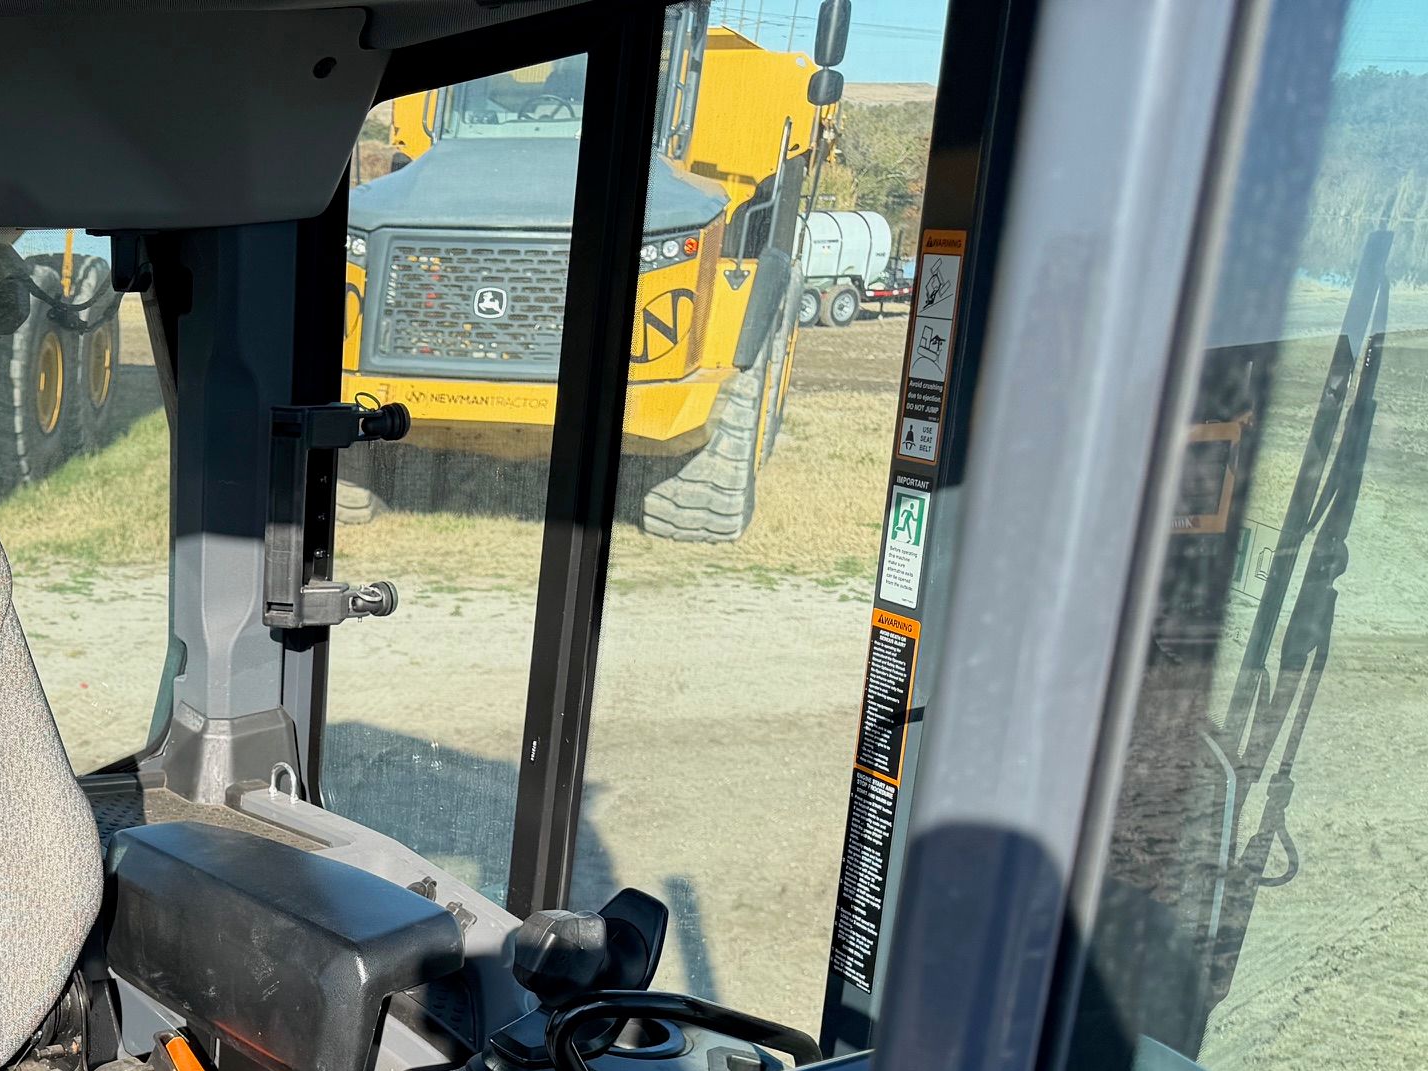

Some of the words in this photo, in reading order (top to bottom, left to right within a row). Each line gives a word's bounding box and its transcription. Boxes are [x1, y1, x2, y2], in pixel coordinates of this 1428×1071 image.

[931, 236, 962, 250] WARNING
[908, 379, 922, 389] Avoid
[922, 381, 943, 394] crushing
[907, 390, 916, 399] due
[916, 392, 922, 400] to
[906, 401, 914, 410] DO
[914, 402, 924, 412] NOT
[924, 404, 939, 414] JUMP
[922, 426, 932, 434] USE
[920, 434, 932, 443] SEAT
[919, 443, 931, 453] BELT
[896, 475, 930, 490] IMPORTANT
[883, 615, 912, 633] WARNING
